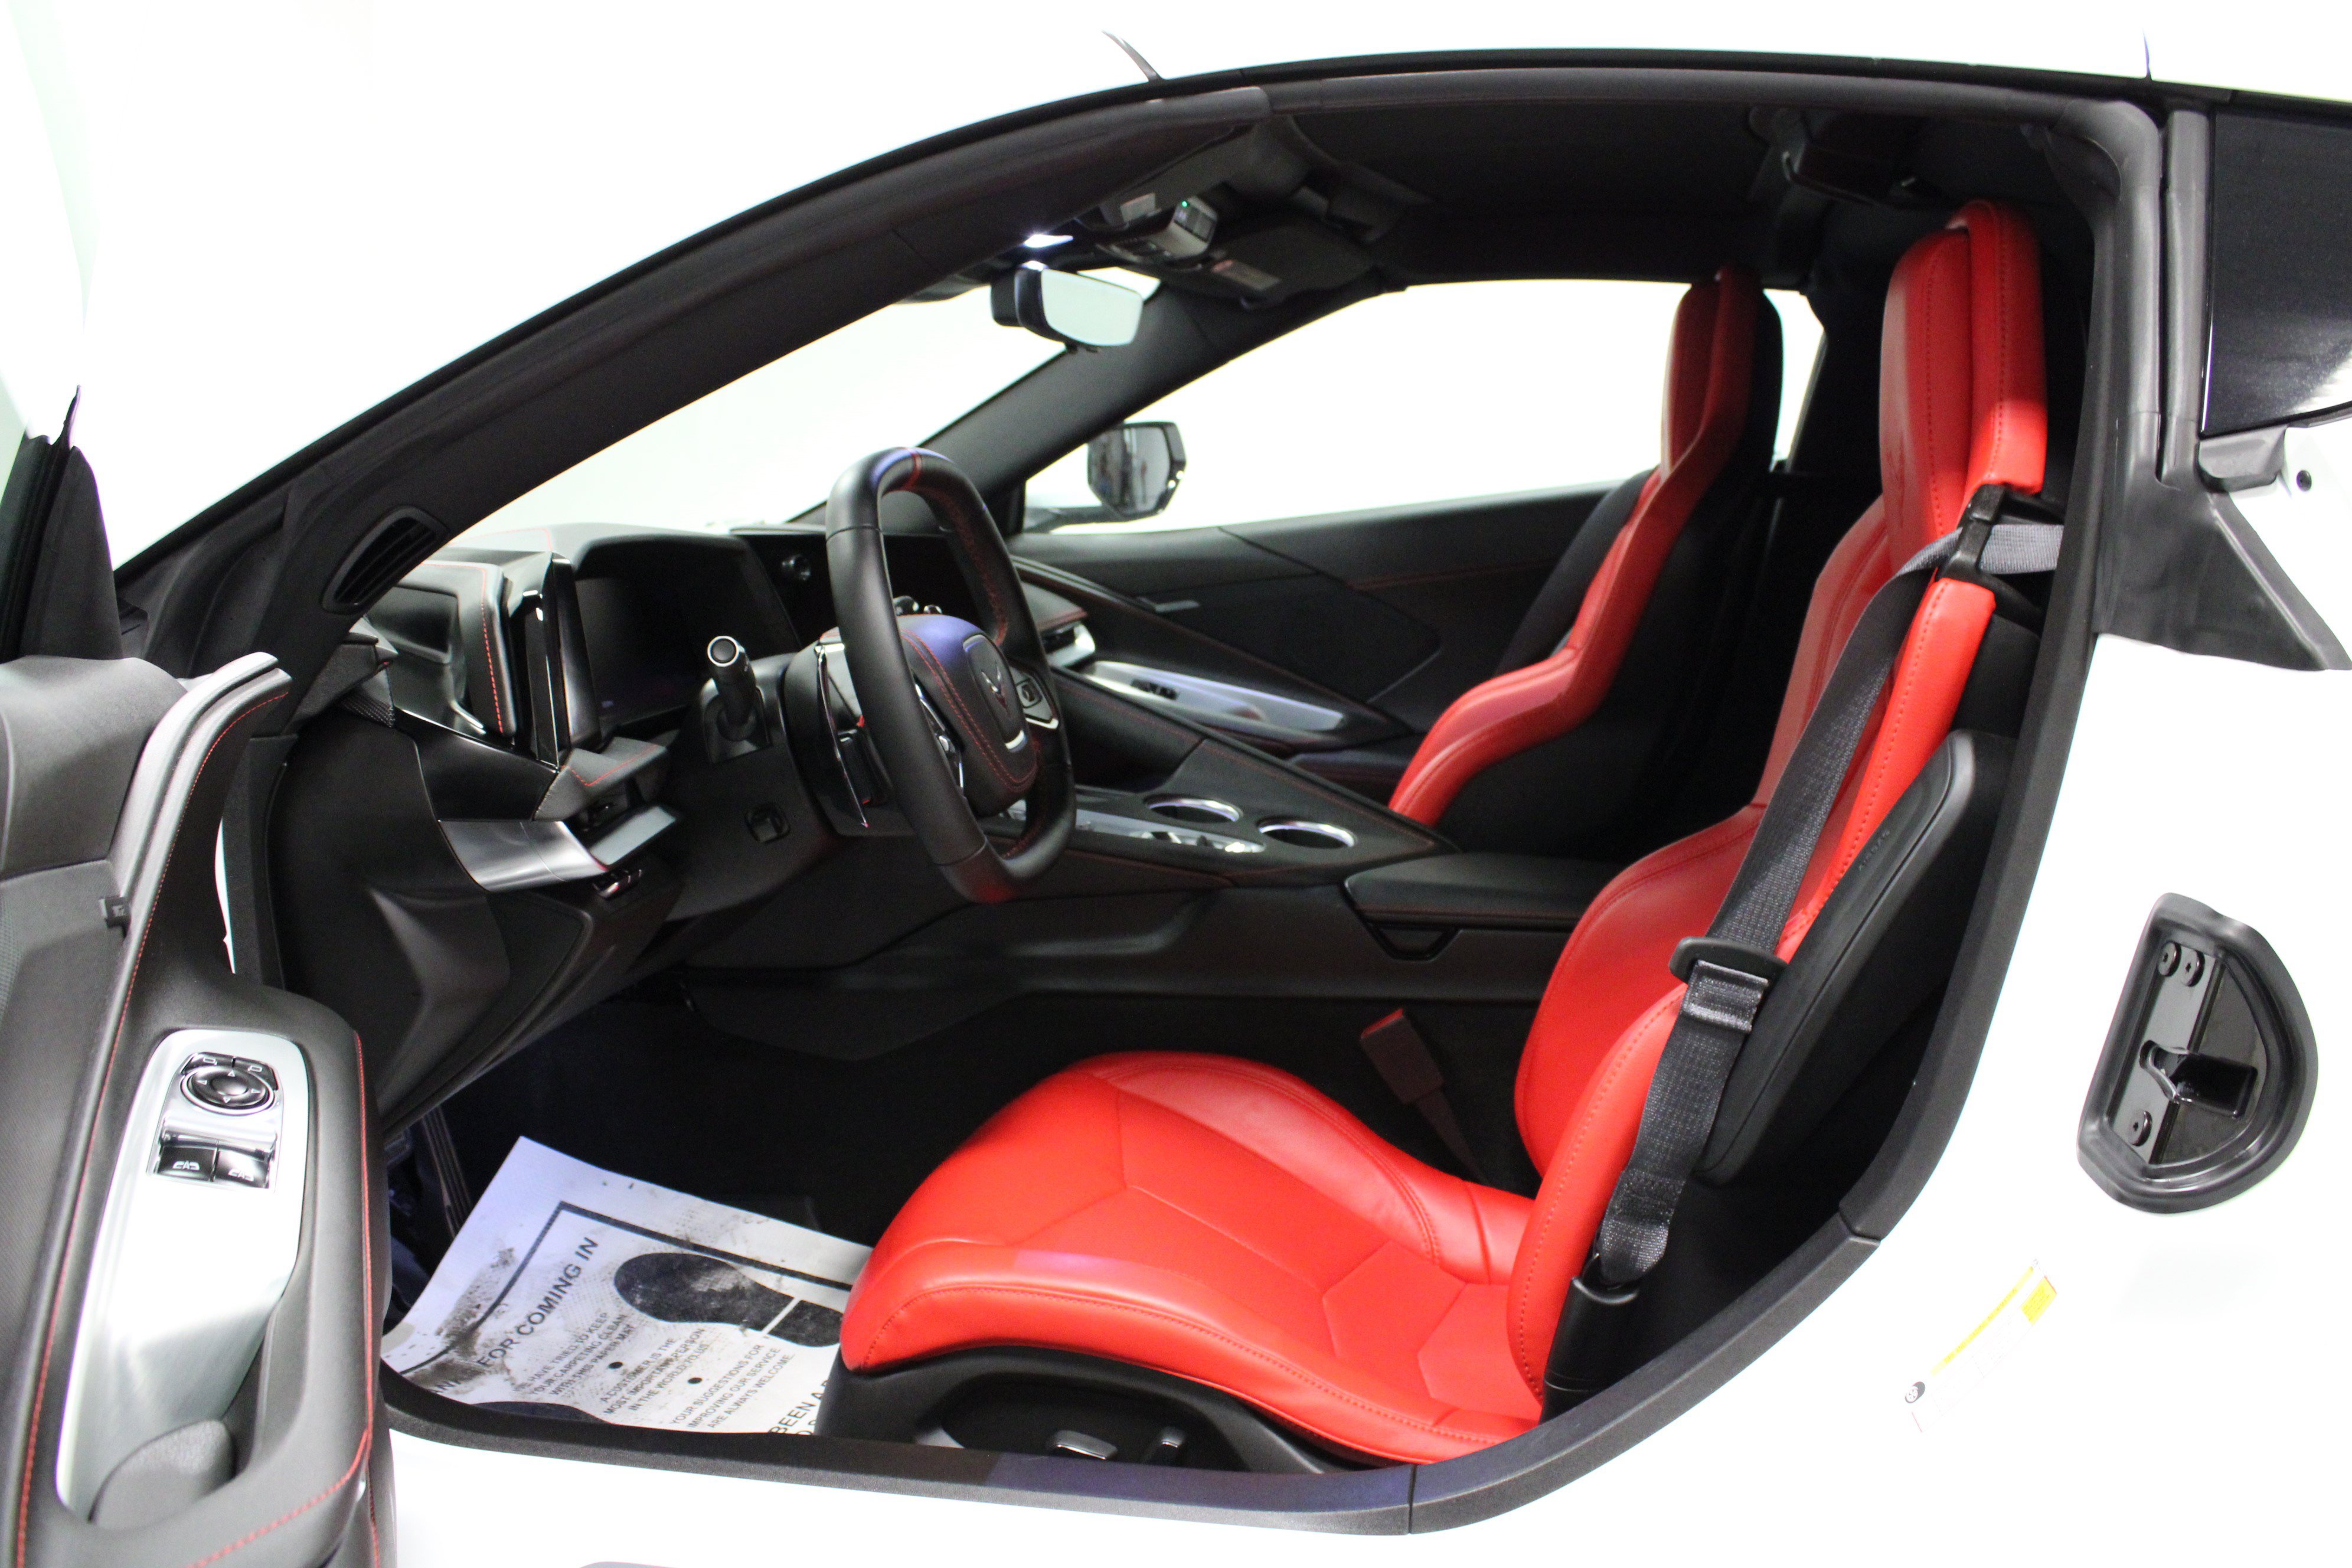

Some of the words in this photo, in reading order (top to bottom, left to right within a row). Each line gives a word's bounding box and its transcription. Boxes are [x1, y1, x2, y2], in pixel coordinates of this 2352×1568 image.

[477, 1339, 520, 1368] FOR
[517, 1263, 582, 1337] COMING
[575, 1236, 599, 1261] IN
[528, 1365, 555, 1381] HAVE
[551, 1345, 580, 1364] TRIED
[575, 1333, 589, 1343] TO
[587, 1312, 607, 1334] KEEP
[528, 1378, 556, 1394] YOUR
[554, 1340, 602, 1378] CARPETING
[598, 1314, 628, 1340] CLEAN
[550, 1378, 576, 1395] WITH
[571, 1364, 594, 1381] THIS
[591, 1340, 621, 1363] PAPER
[617, 1324, 636, 1341] MAT
[603, 1394, 630, 1415] MOST
[628, 1357, 674, 1396] IMPORTANT
[671, 1328, 705, 1360] PERSON
[606, 1360, 652, 1397] CUSTOMER
[650, 1352, 662, 1363] IS
[657, 1338, 677, 1354] THE
[628, 1402, 643, 1412] IN
[638, 1388, 659, 1404] THE
[655, 1366, 687, 1389] WORLD
[684, 1354, 698, 1366] TO
[670, 1405, 699, 1426] YOUR
[692, 1360, 749, 1407] SUGGESTIONS
[744, 1344, 765, 1361] FOR
[687, 1391, 733, 1429] IMPROVING
[730, 1377, 749, 1394] OUR
[746, 1347, 781, 1378] SERVICE
[707, 1414, 729, 1429] ARE
[724, 1388, 759, 1415] ALWAYS
[753, 1353, 795, 1391] WELCOME.
[767, 1401, 816, 1434] BEEN
